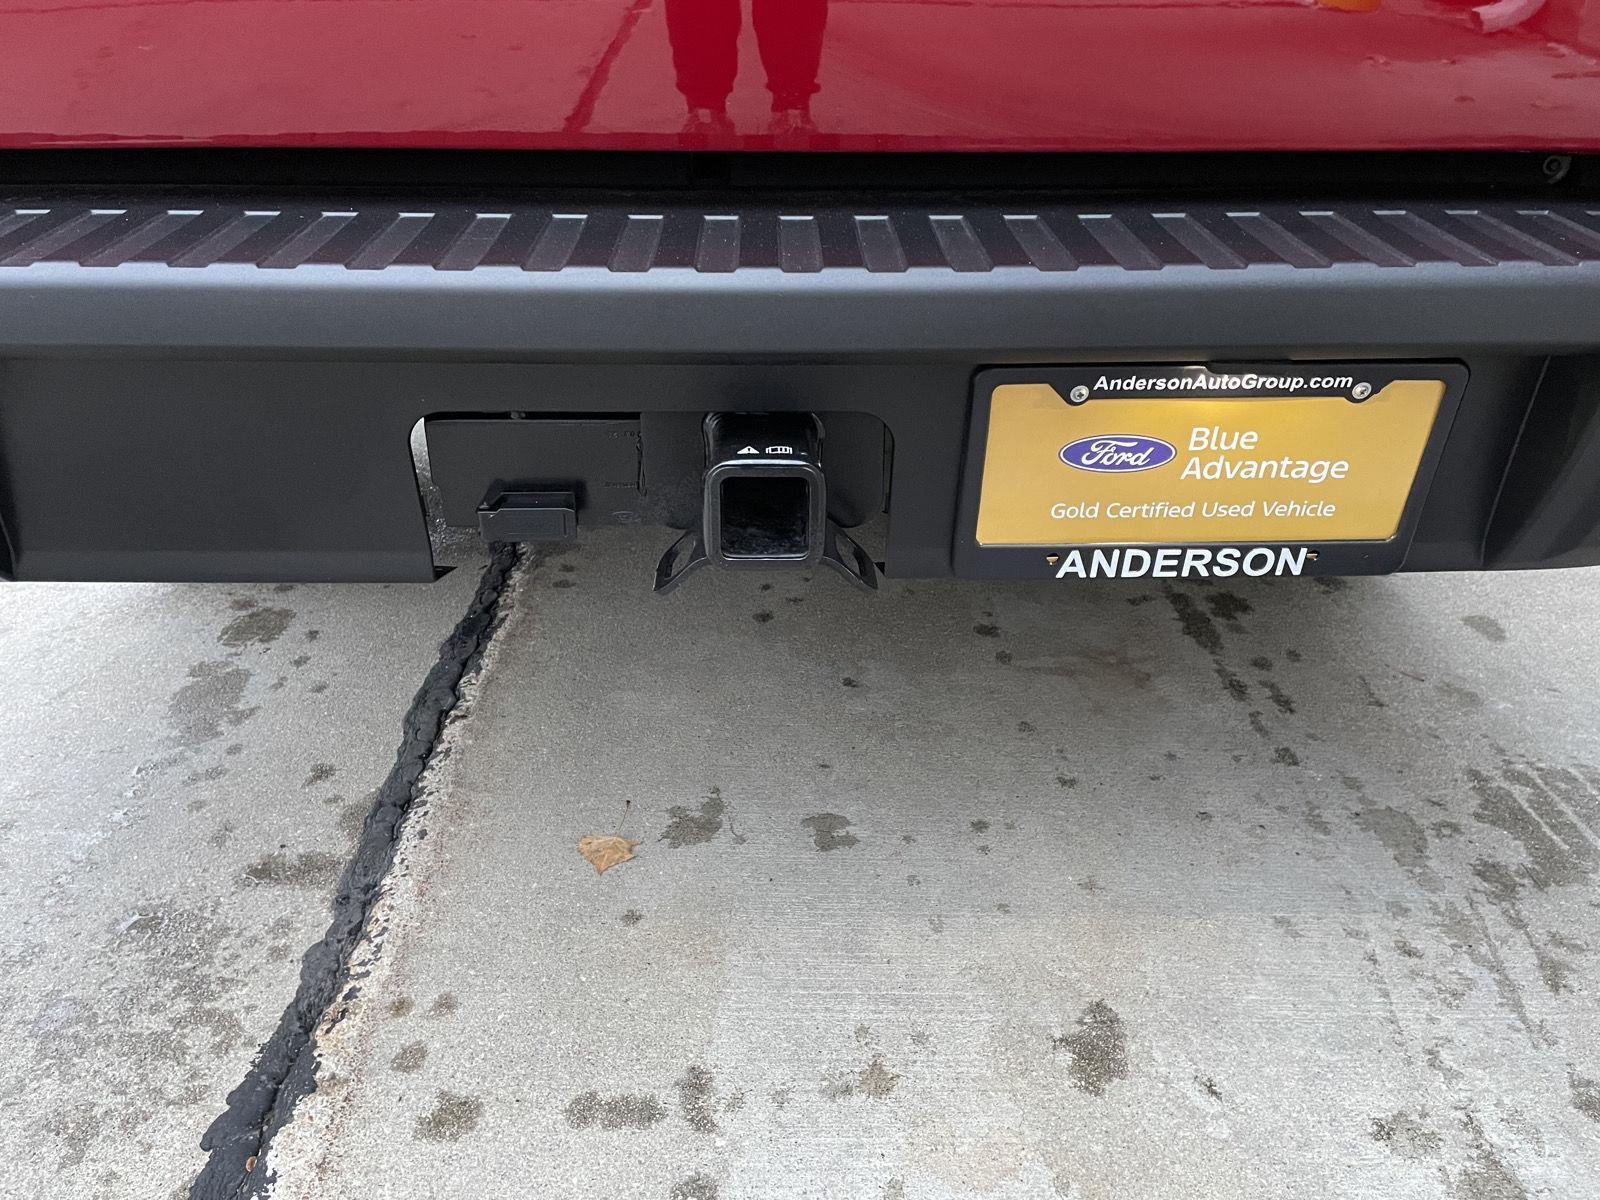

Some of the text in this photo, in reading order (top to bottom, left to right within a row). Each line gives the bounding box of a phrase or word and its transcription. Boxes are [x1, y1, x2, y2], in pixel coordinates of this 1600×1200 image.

[1094, 375, 1353, 392] AndersonAutoGroup.com
[1189, 427, 1258, 450] Blue
[1080, 440, 1153, 467] Ford
[1181, 456, 1349, 484] Advantage
[1051, 500, 1336, 519] Gold Certified Used Vehicle
[1056, 548, 1307, 578] ANDERSON
